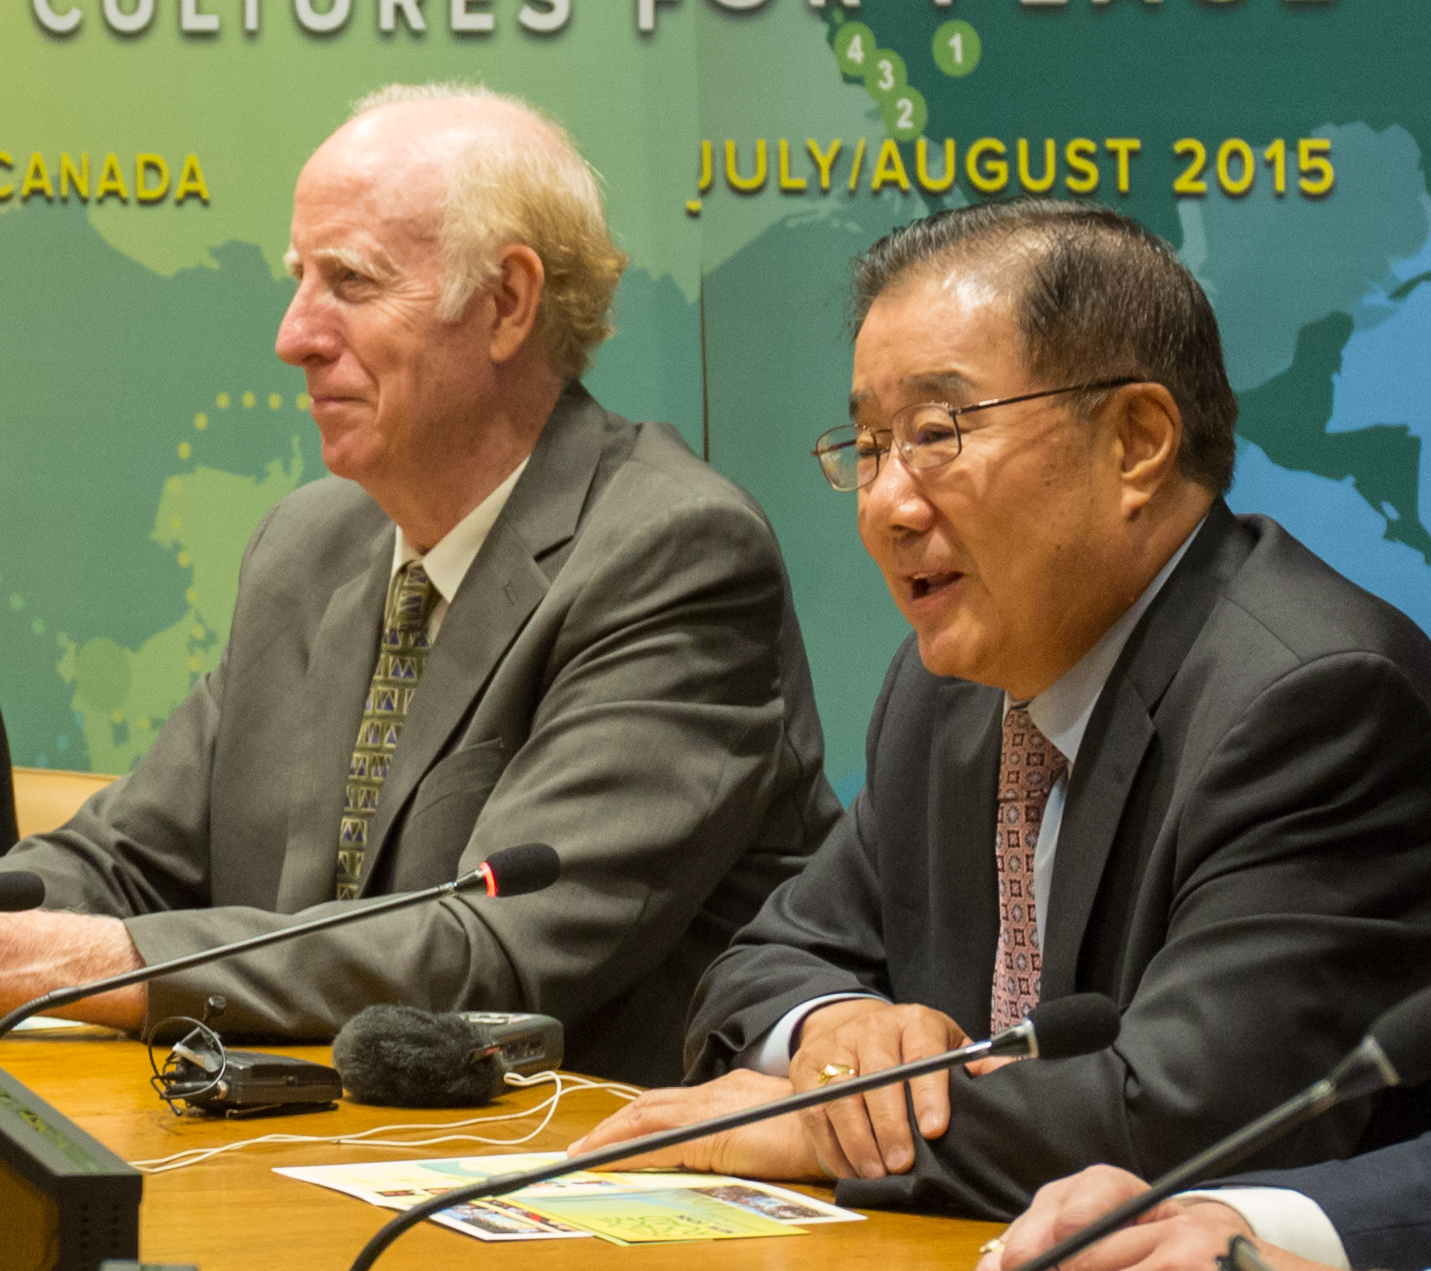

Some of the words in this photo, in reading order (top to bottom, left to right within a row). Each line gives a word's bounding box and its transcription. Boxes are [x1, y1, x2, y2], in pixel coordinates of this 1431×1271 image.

[847, 34, 864, 64] 4
[949, 32, 963, 64] 1
[879, 60, 895, 90] 3
[897, 98, 914, 129] 2
[687, 137, 1141, 208] JULY/AUGUST
[1173, 138, 1335, 194] 2015
